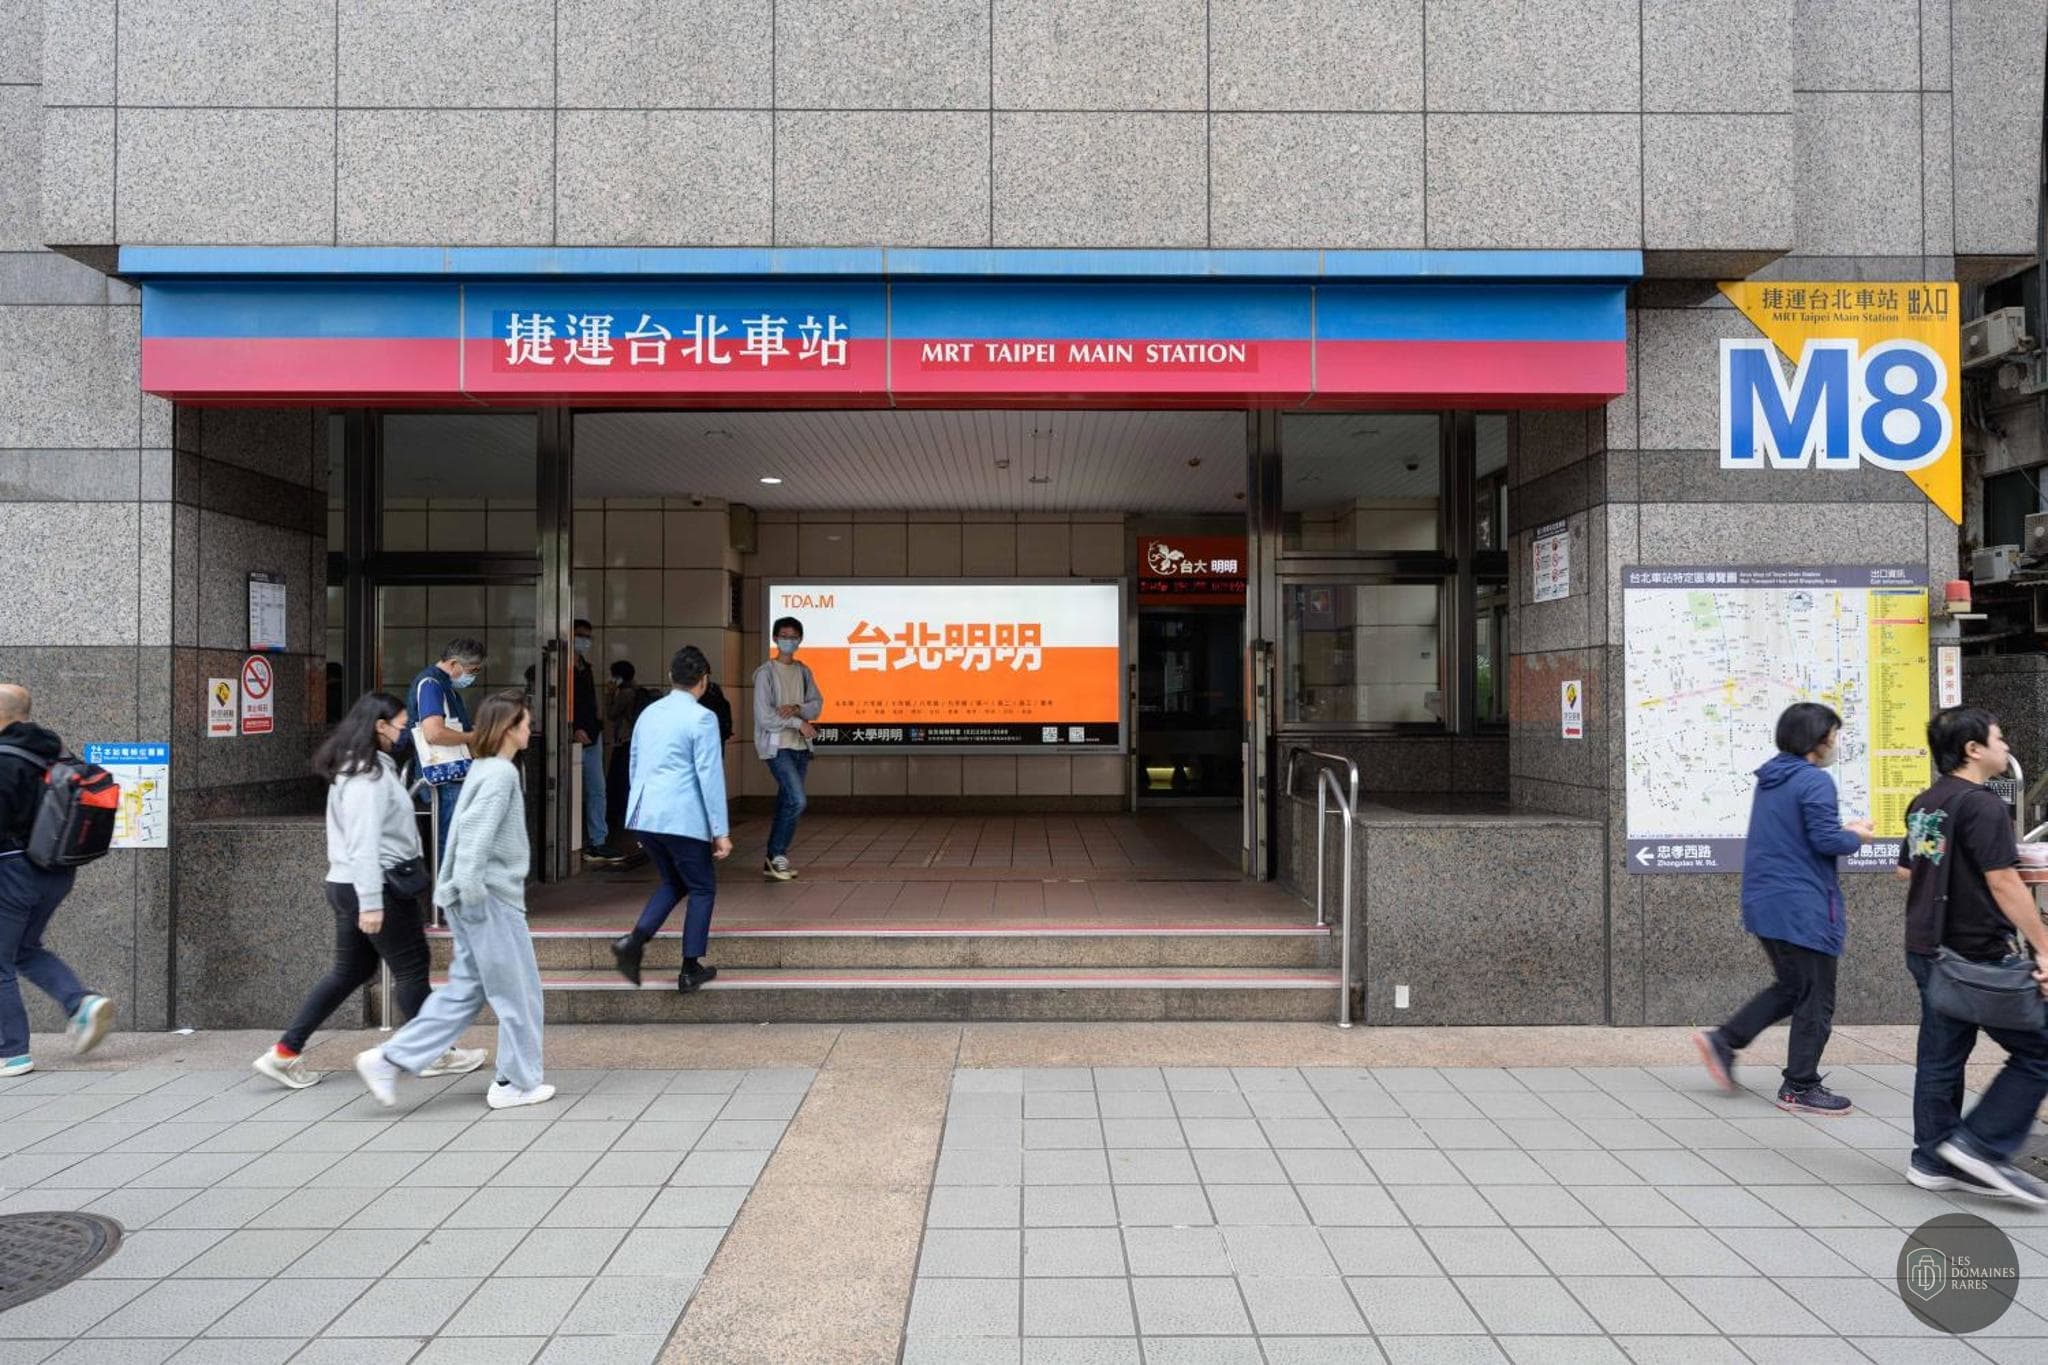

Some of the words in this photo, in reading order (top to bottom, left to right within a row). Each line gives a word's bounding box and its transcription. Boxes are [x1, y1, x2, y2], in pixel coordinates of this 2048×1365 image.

[1762, 287, 1899, 310] 捷運台北車站
[1907, 284, 1948, 315] 出入口
[1772, 312, 1795, 322] MRT
[1800, 312, 1831, 324] Taipei
[1833, 312, 1859, 322] Main
[1863, 312, 1899, 322] Station
[504, 312, 849, 367] 捷運台北車站
[921, 343, 974, 363] MRT
[985, 343, 1055, 363] TAIPEI
[1068, 343, 1133, 363] MAIN
[1146, 343, 1246, 363] STATION
[1720, 338, 1953, 471] M8
[1180, 559, 1208, 574] 台大
[1211, 559, 1238, 574] 明明
[781, 595, 834, 609] TDA.M
[847, 620, 1043, 672] 台北明明
[1657, 844, 1712, 859] 忠孝西路
